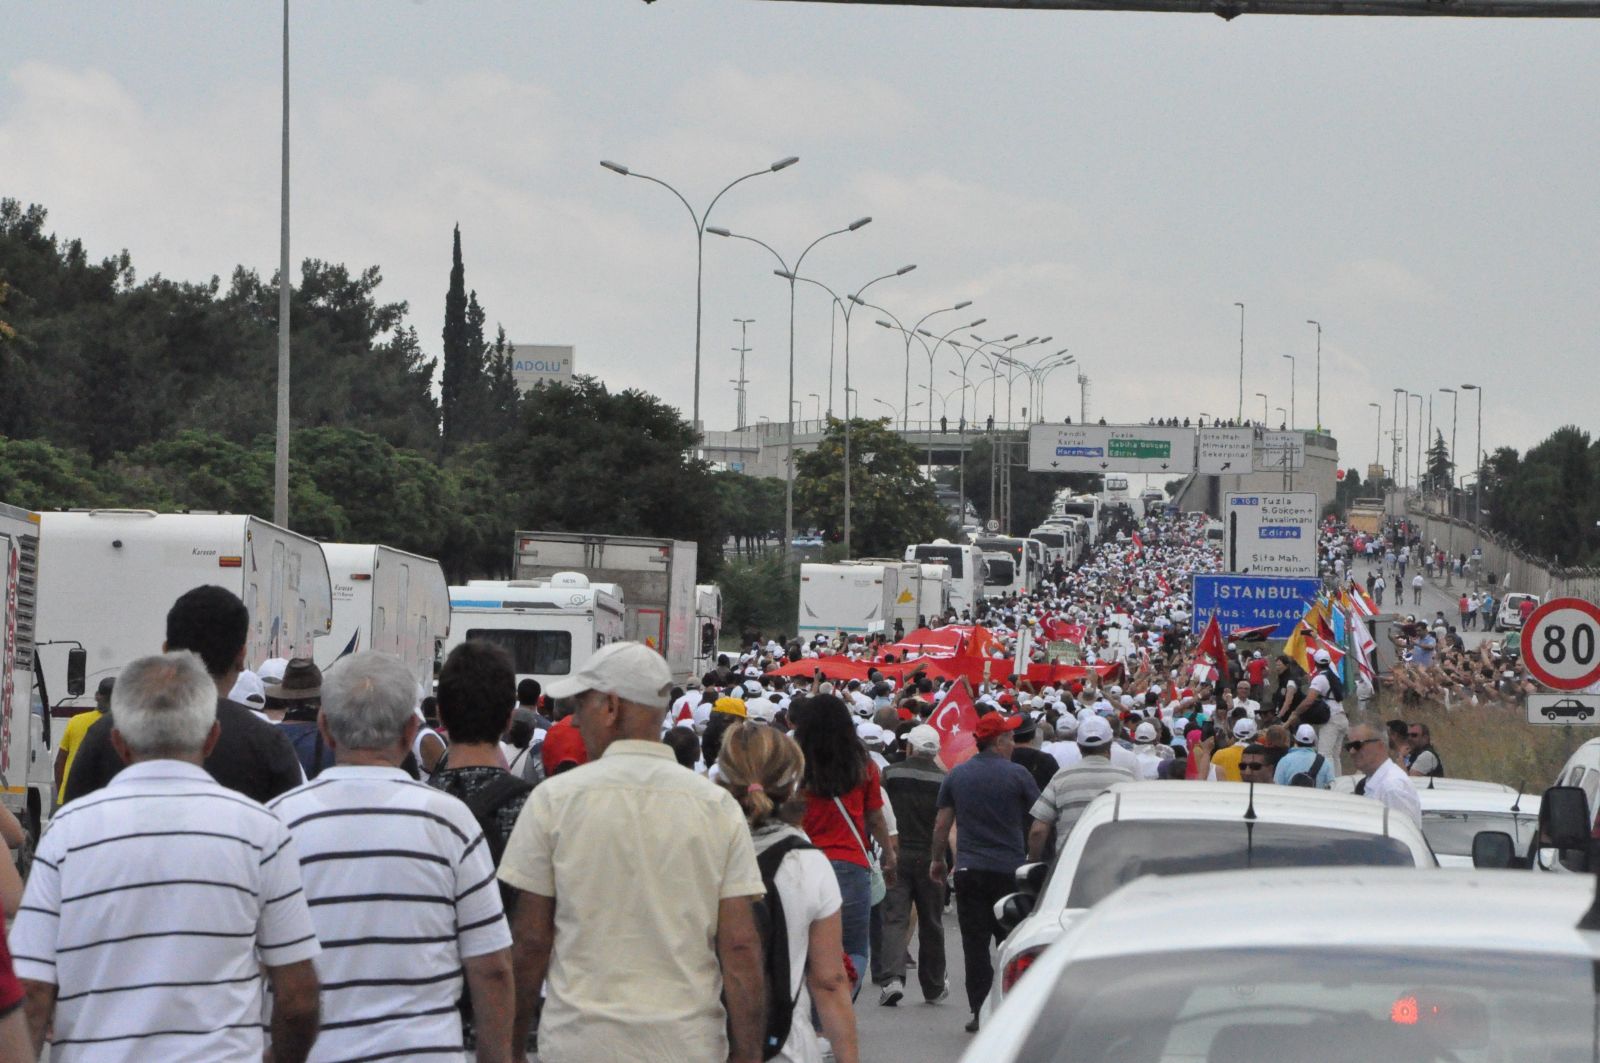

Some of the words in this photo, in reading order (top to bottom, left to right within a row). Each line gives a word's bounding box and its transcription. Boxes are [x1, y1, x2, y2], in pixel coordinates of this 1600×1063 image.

[511, 360, 560, 372] ADOLU
[1262, 497, 1292, 505] Tuzla
[1261, 528, 1298, 536] Edirne
[1252, 564, 1311, 573] Mimarsinan
[1213, 582, 1300, 599] İSTANBUL
[1543, 623, 1595, 665] 80
